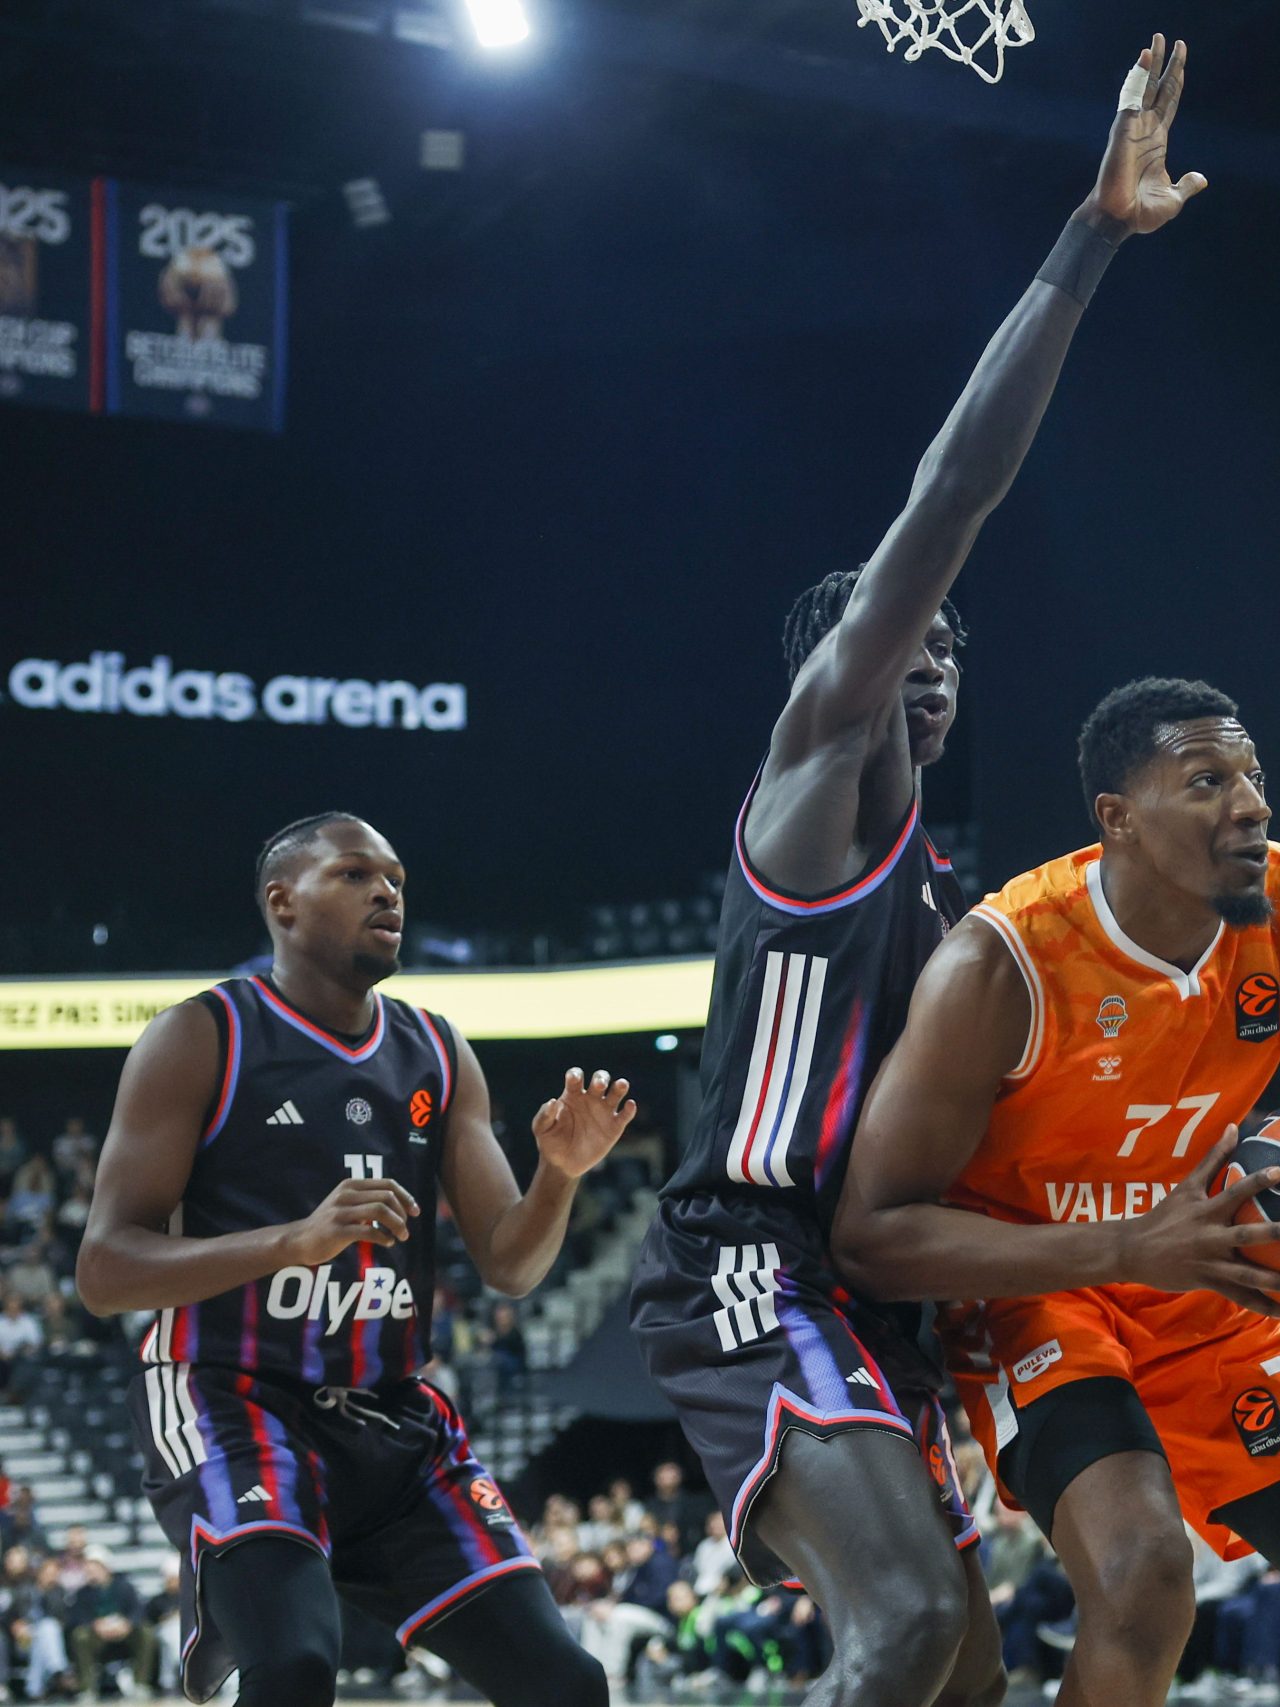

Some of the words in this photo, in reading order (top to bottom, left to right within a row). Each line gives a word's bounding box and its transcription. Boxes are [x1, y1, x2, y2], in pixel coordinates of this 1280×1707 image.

[139, 203, 256, 269] 2025
[8, 650, 256, 722] adidas
[262, 675, 468, 731] arena
[49, 1002, 100, 1027] PAS
[112, 1000, 168, 1024] SIM
[1256, 1023, 1278, 1034] dhabi
[1116, 1092, 1221, 1157] 77
[1045, 1182, 1178, 1223] VALEN
[267, 1264, 418, 1336] OlyBe
[1017, 1347, 1057, 1377] PULEVA
